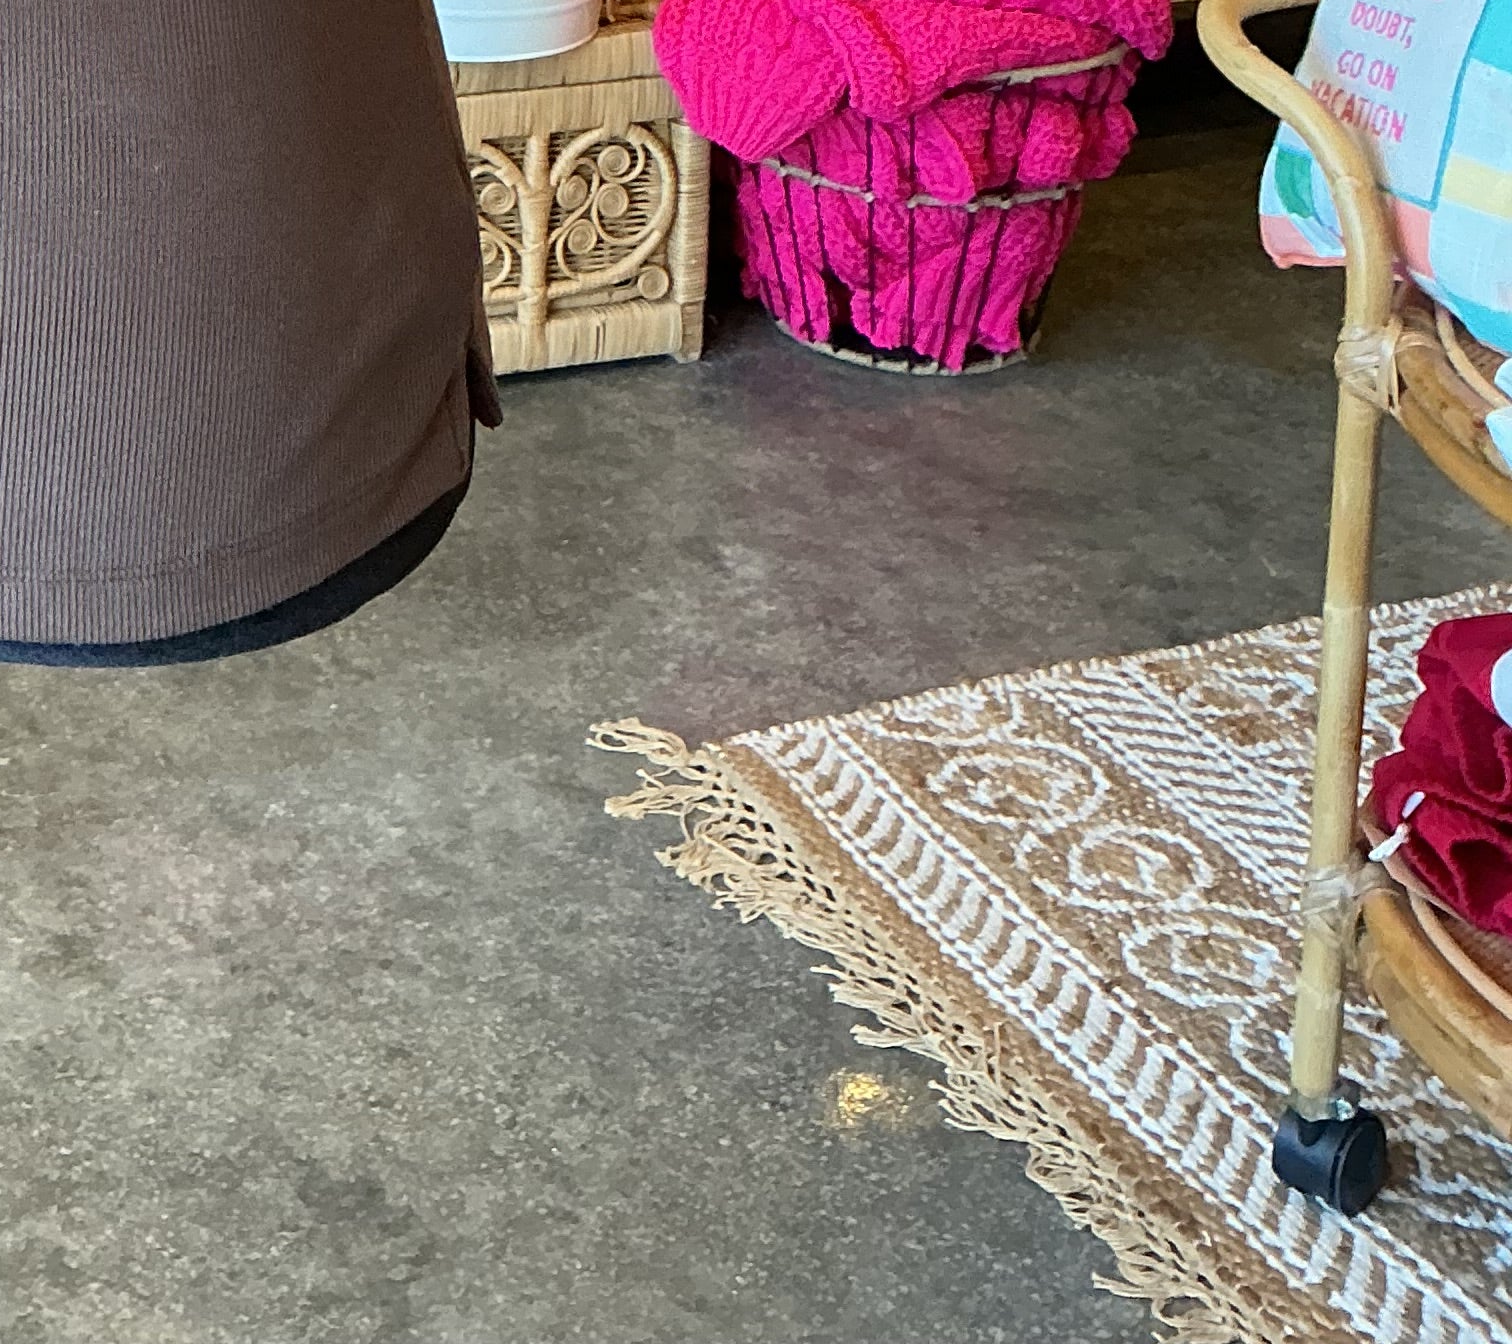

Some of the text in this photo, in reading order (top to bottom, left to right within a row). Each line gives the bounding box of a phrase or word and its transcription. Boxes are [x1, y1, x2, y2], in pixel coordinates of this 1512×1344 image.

[1351, 1, 1415, 49] DOUBT,
[1338, 50, 1398, 91] GO ON
